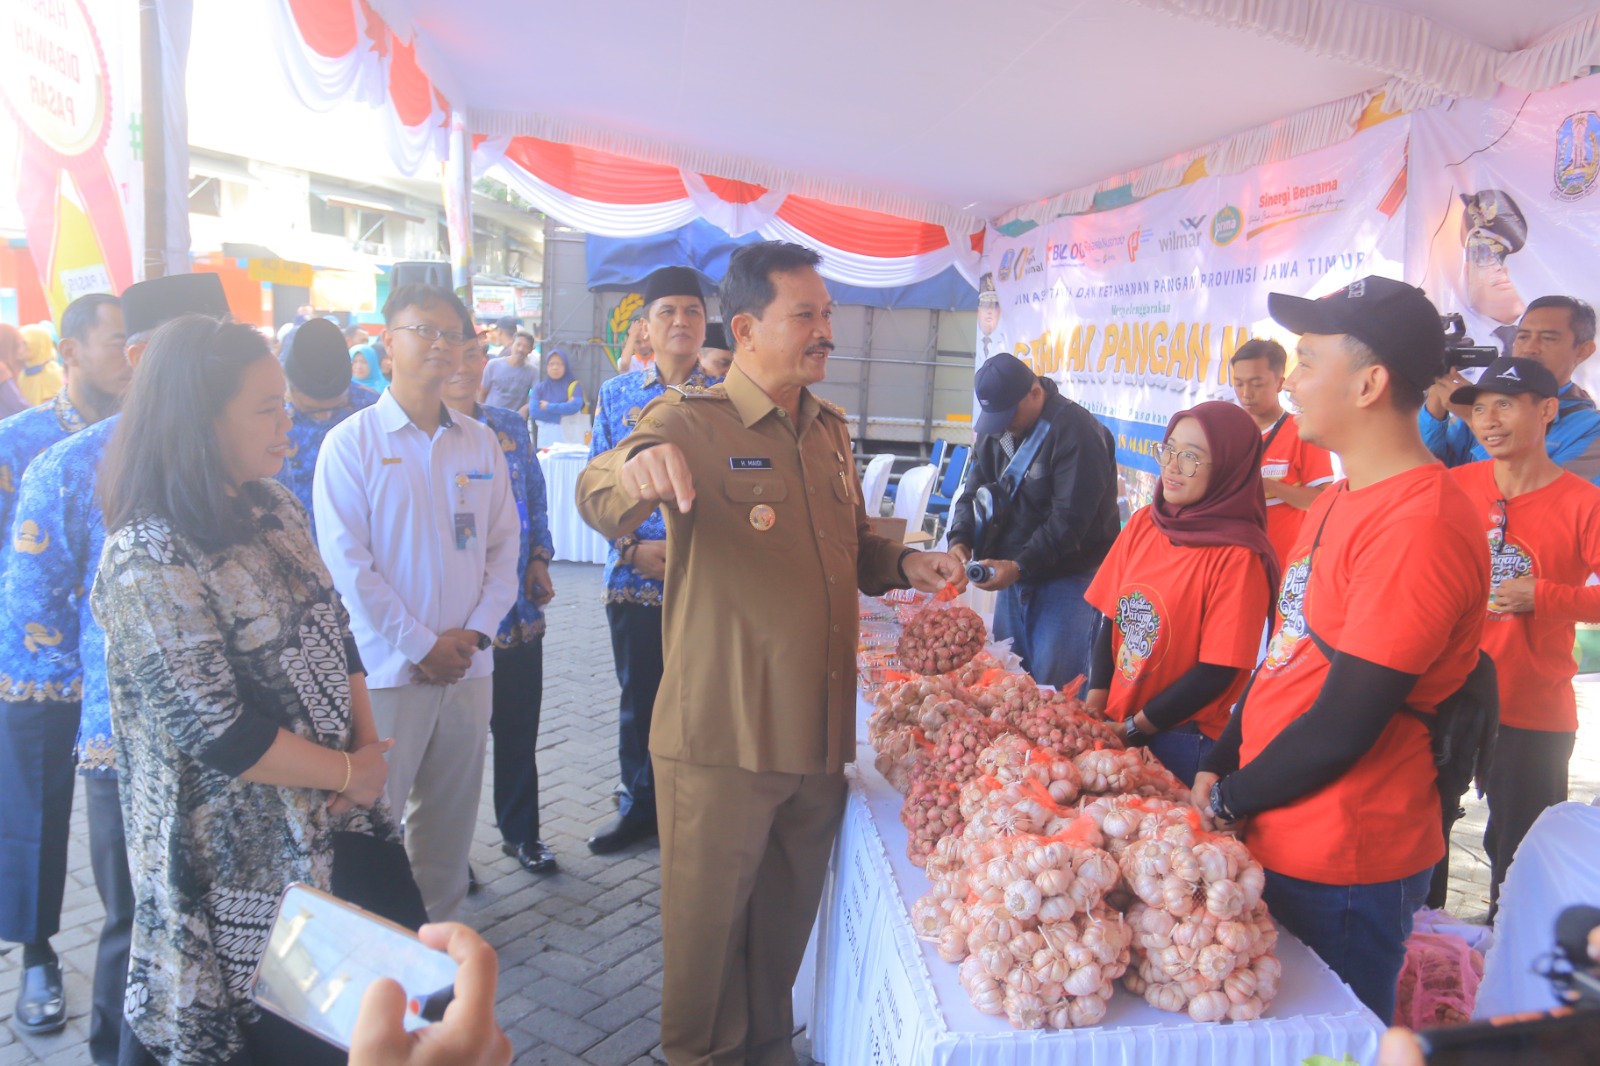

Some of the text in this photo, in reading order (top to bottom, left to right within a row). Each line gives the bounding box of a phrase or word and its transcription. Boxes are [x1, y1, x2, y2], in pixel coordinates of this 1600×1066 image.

[1259, 179, 1338, 208] Sinergi Bersama
[1158, 230, 1202, 252] wilmar
[1098, 281, 1149, 298] KETAHANAN
[1154, 276, 1197, 293] PANGAN
[1200, 266, 1257, 288] PROVINSI
[1263, 260, 1299, 281] JAWA
[1098, 320, 1212, 383] PANGAN
[1127, 407, 1168, 425] Pasokan
